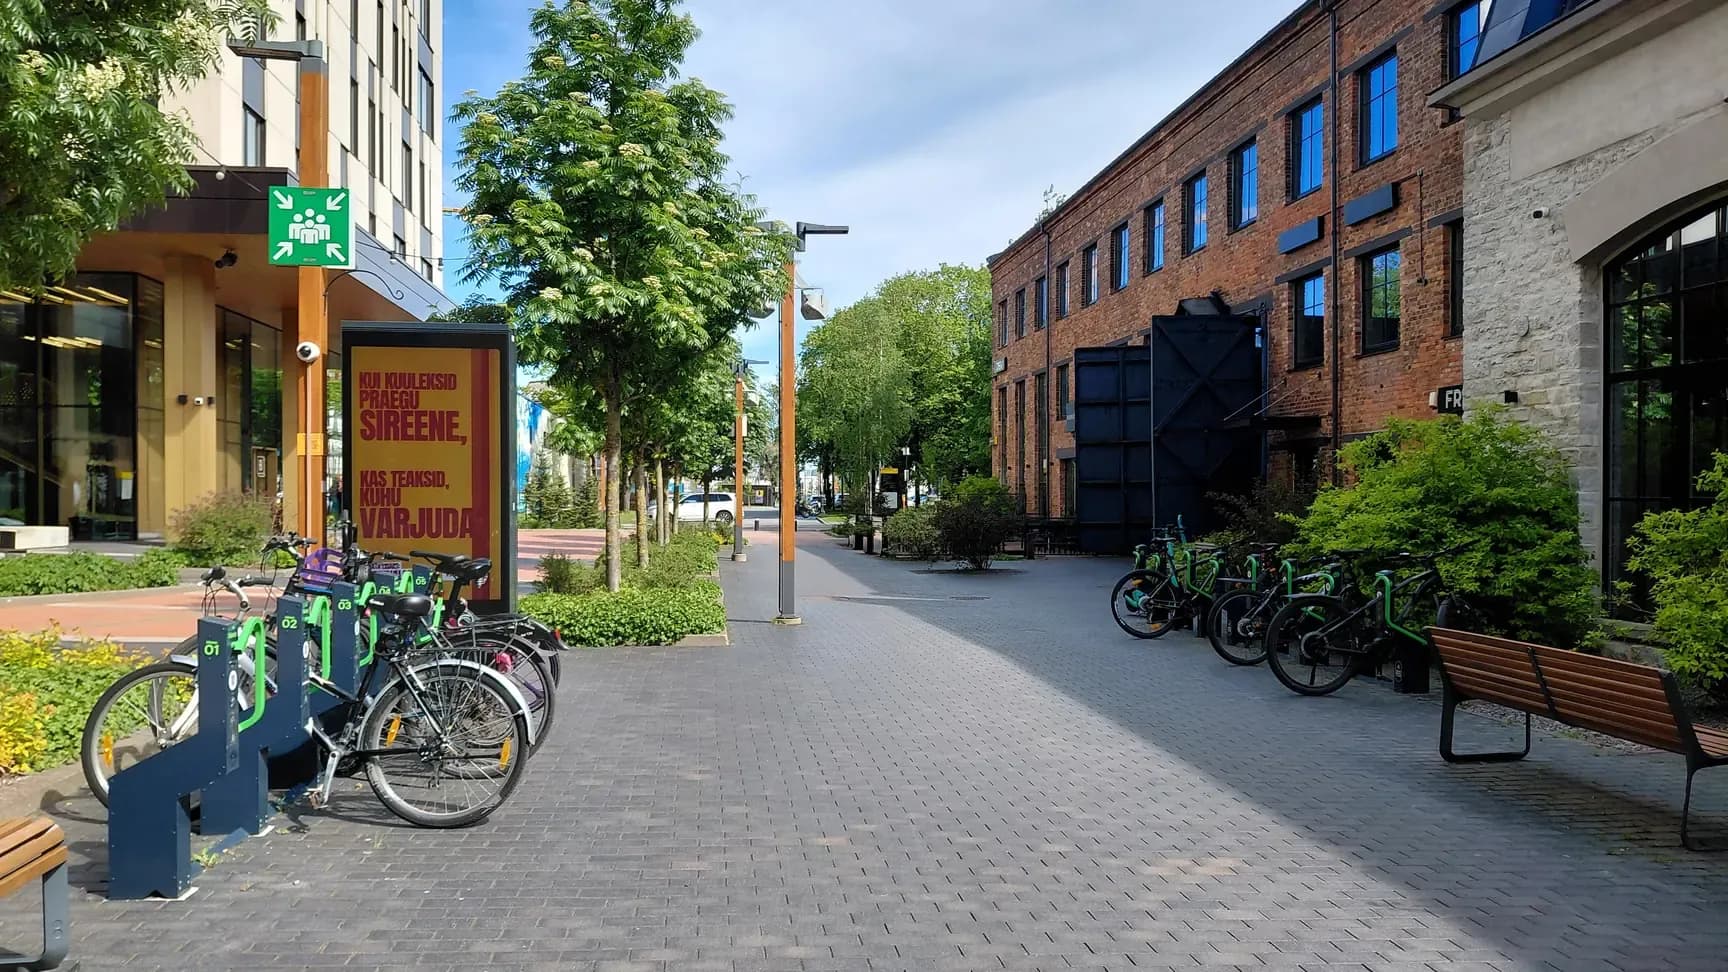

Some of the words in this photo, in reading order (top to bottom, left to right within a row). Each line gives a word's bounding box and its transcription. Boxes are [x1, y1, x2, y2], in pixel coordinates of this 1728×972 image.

[359, 372, 381, 389] KUI
[384, 372, 457, 390] KUULEKSID
[359, 390, 420, 409] PRAEGU
[360, 410, 467, 445] SIREENE,
[360, 470, 387, 487] KAS
[390, 470, 449, 489] TEAKSID,
[360, 488, 401, 506] KUHU
[338, 601, 352, 610] 03
[281, 619, 298, 629] 02
[204, 644, 219, 656] 01
